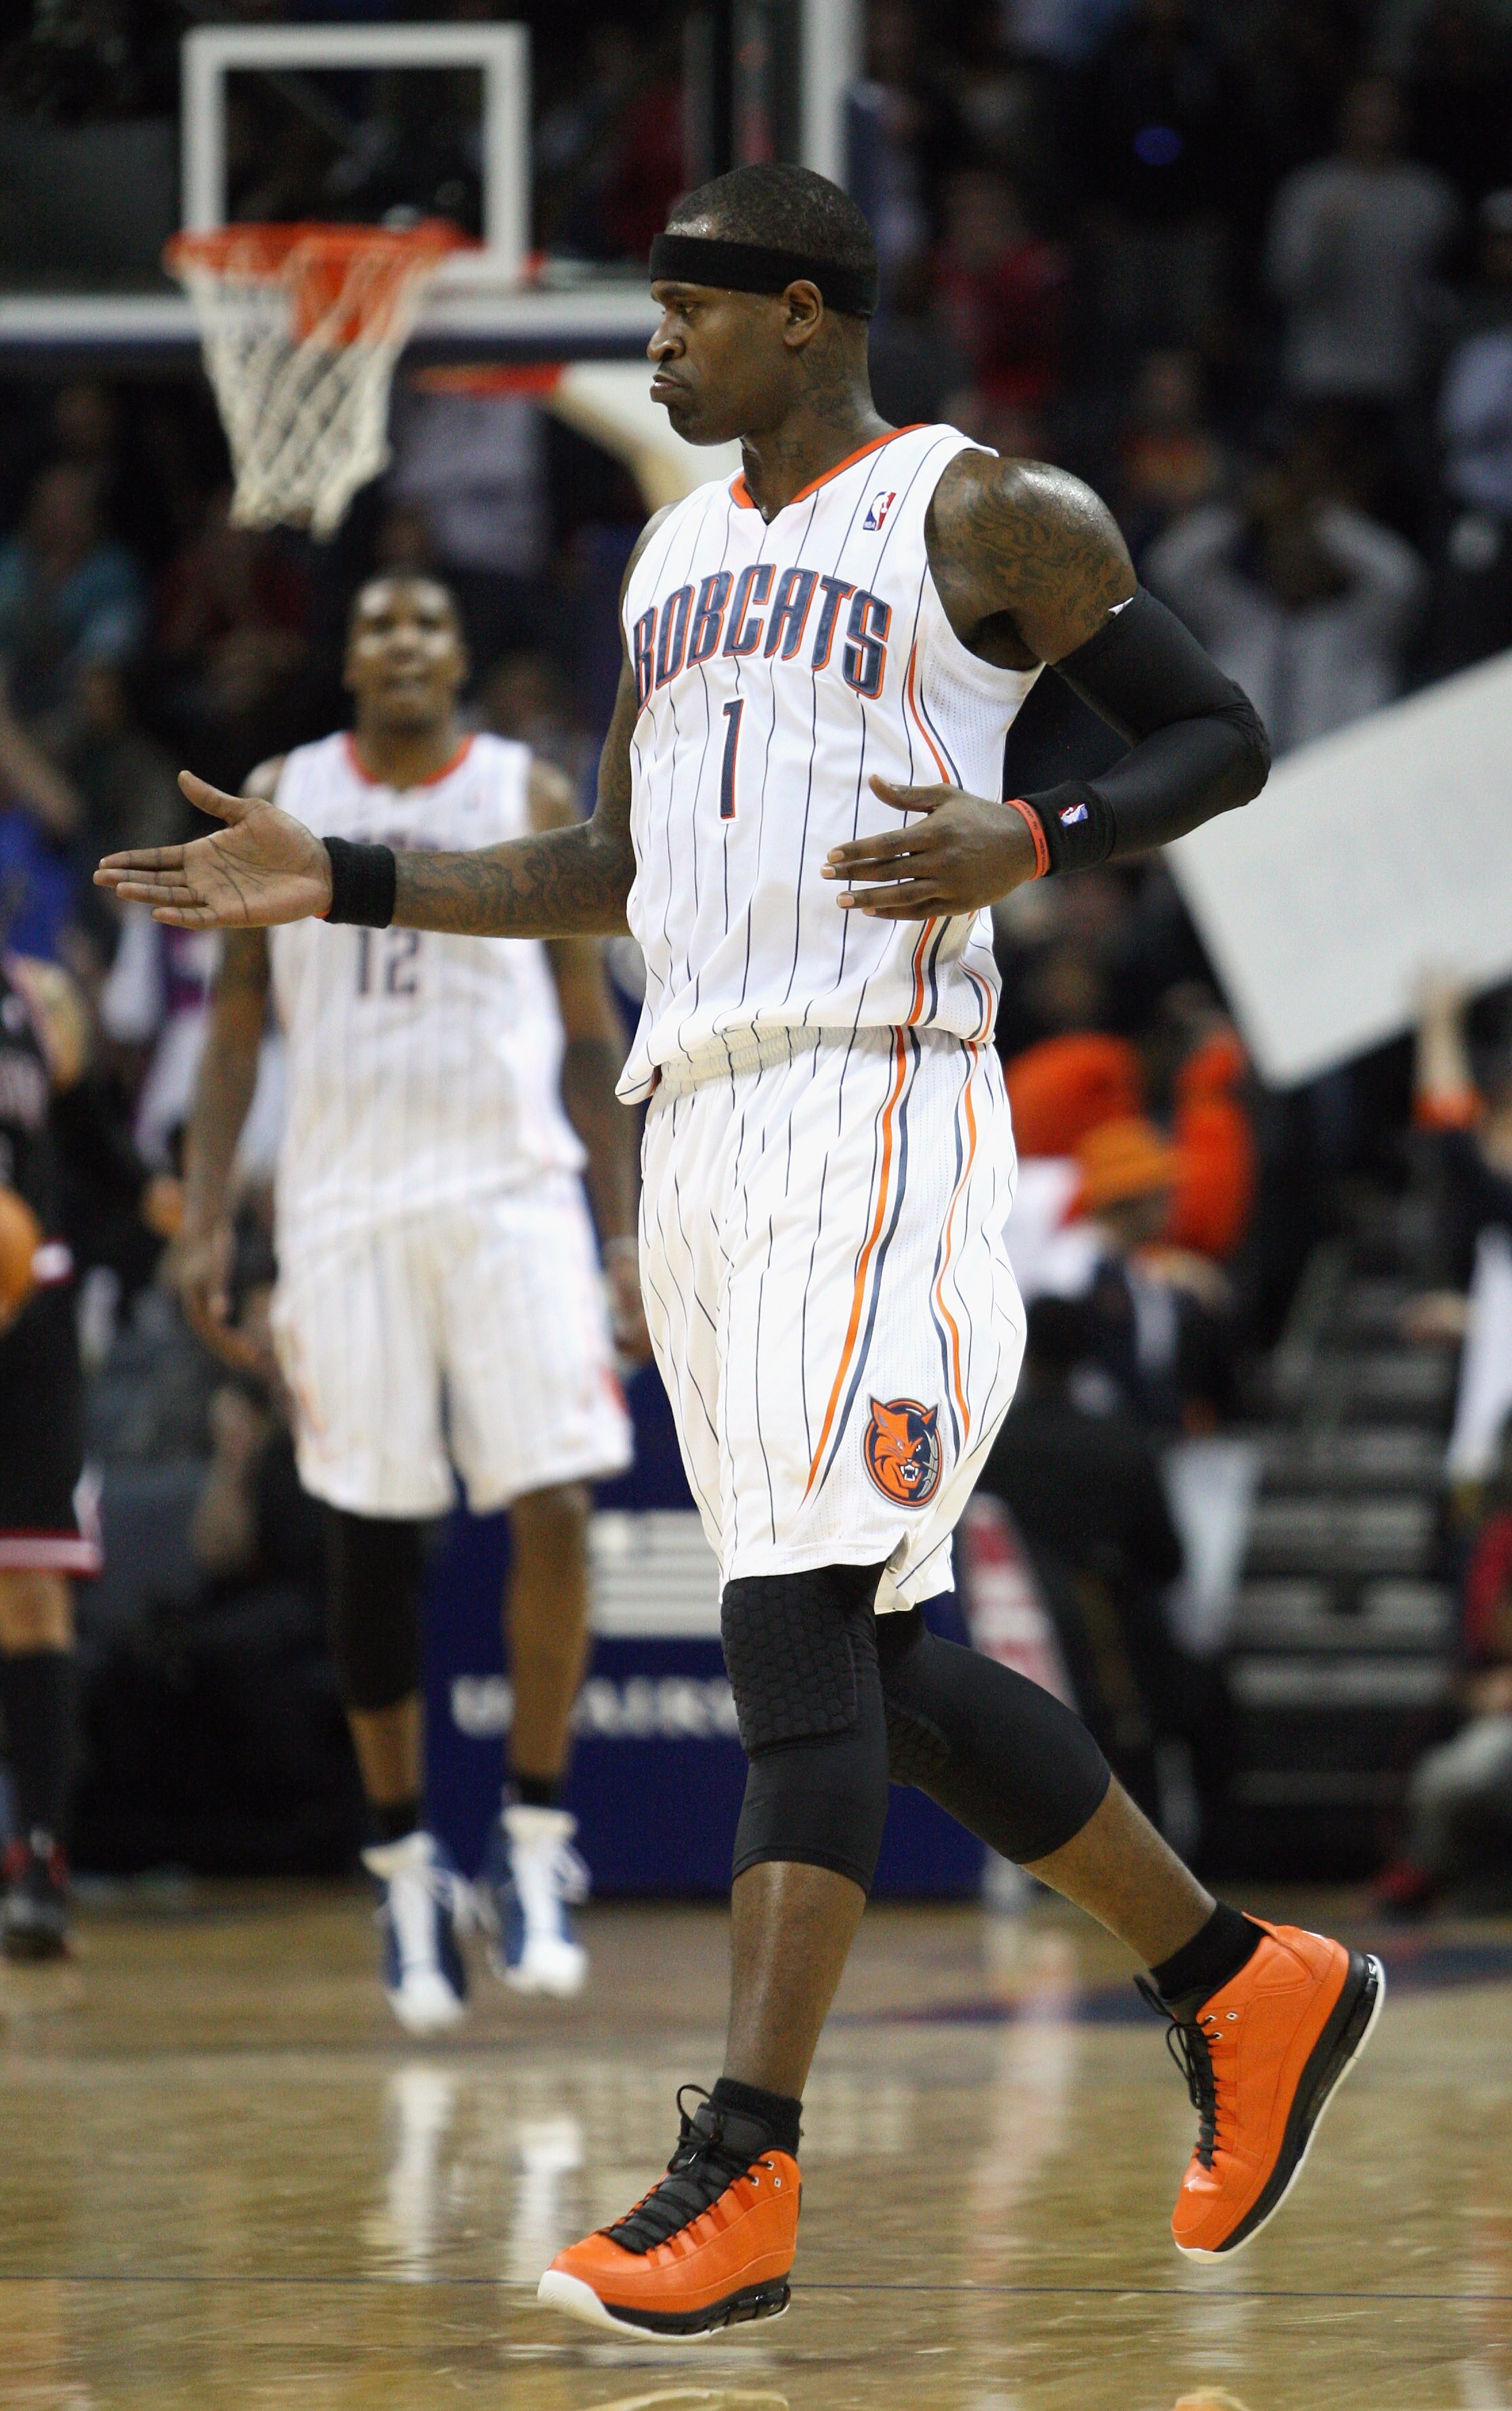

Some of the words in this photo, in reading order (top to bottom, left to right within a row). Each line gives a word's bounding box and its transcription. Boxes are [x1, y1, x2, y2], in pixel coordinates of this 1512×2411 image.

[633, 563, 892, 721] BOBCATS
[719, 698, 745, 820] 1
[356, 926, 420, 998] 12
